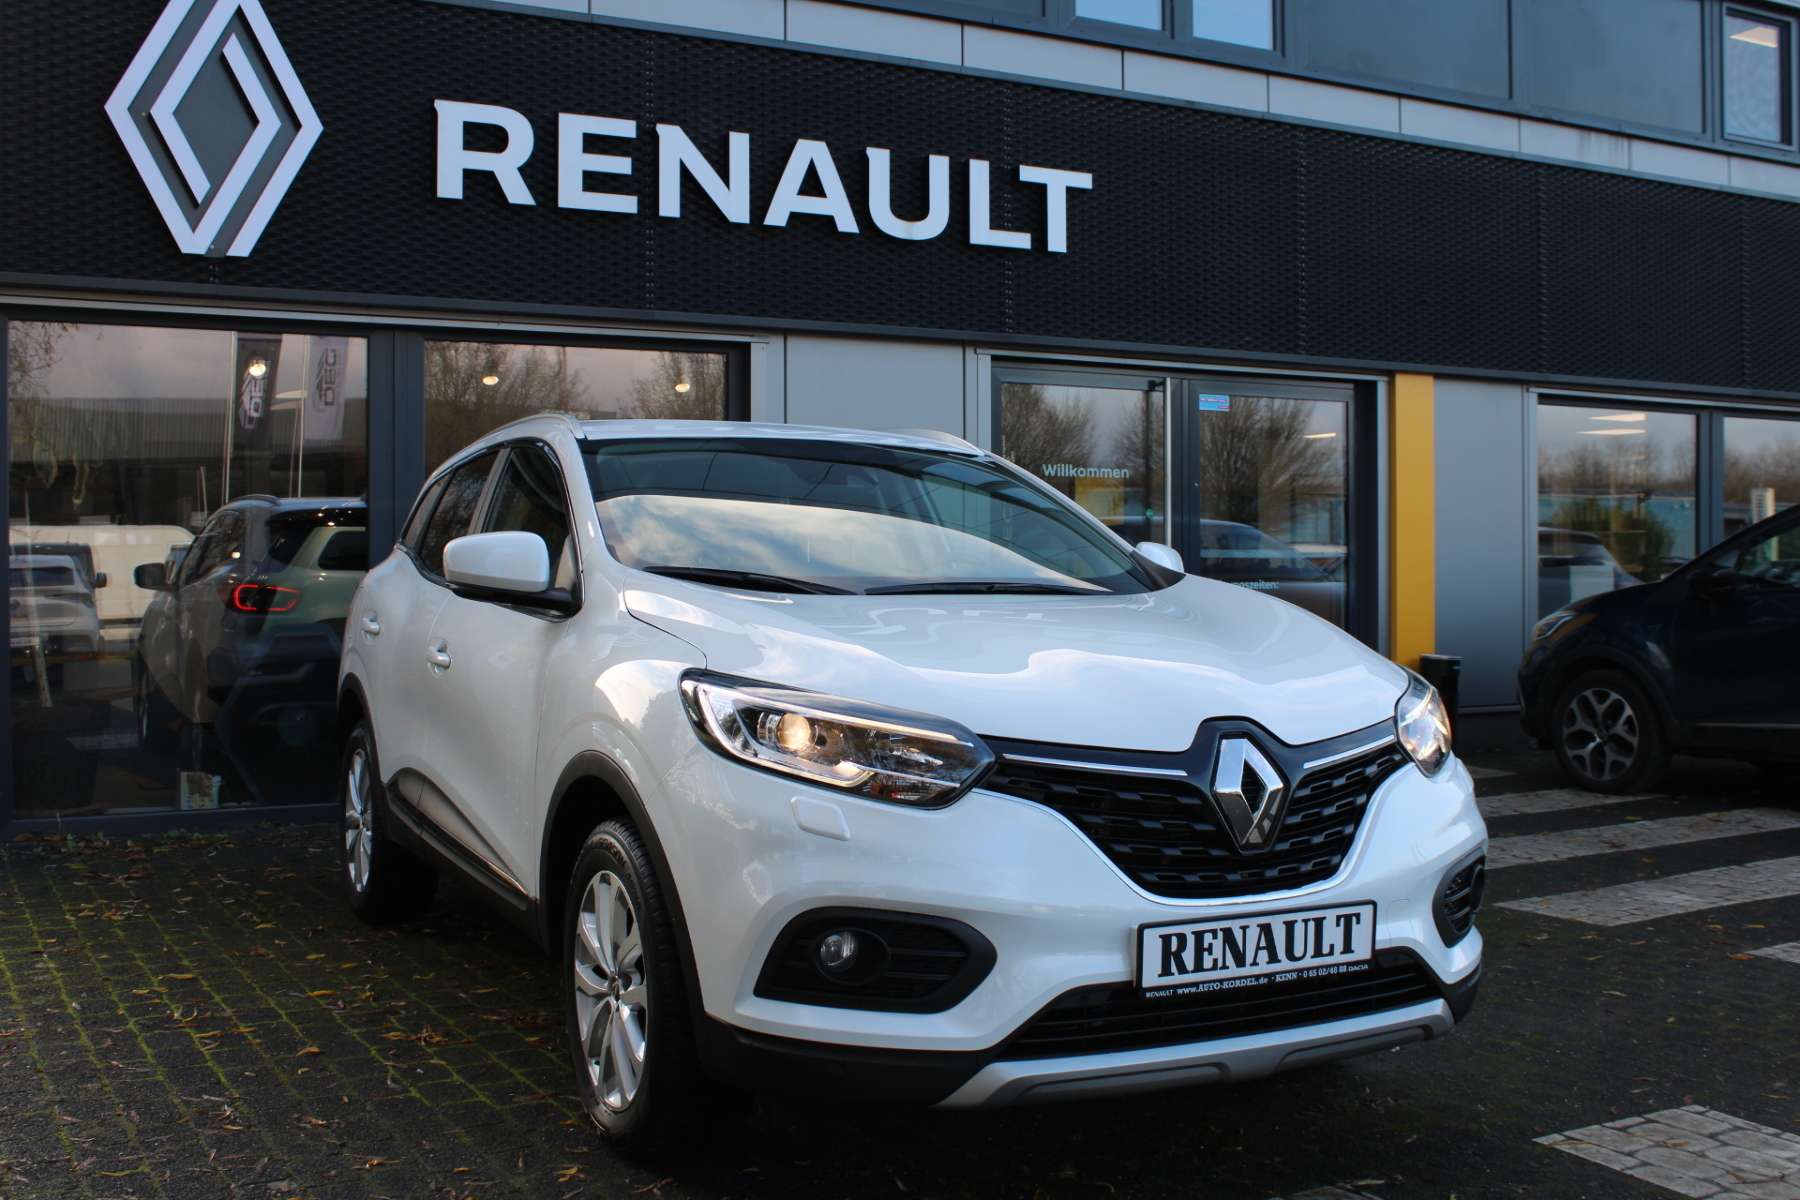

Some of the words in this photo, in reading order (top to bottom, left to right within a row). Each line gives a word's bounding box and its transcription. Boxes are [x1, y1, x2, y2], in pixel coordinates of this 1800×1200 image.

[434, 99, 1093, 254] RENAULT
[1042, 463, 1130, 479] Willkommen
[1157, 912, 1361, 978] RENAULT
